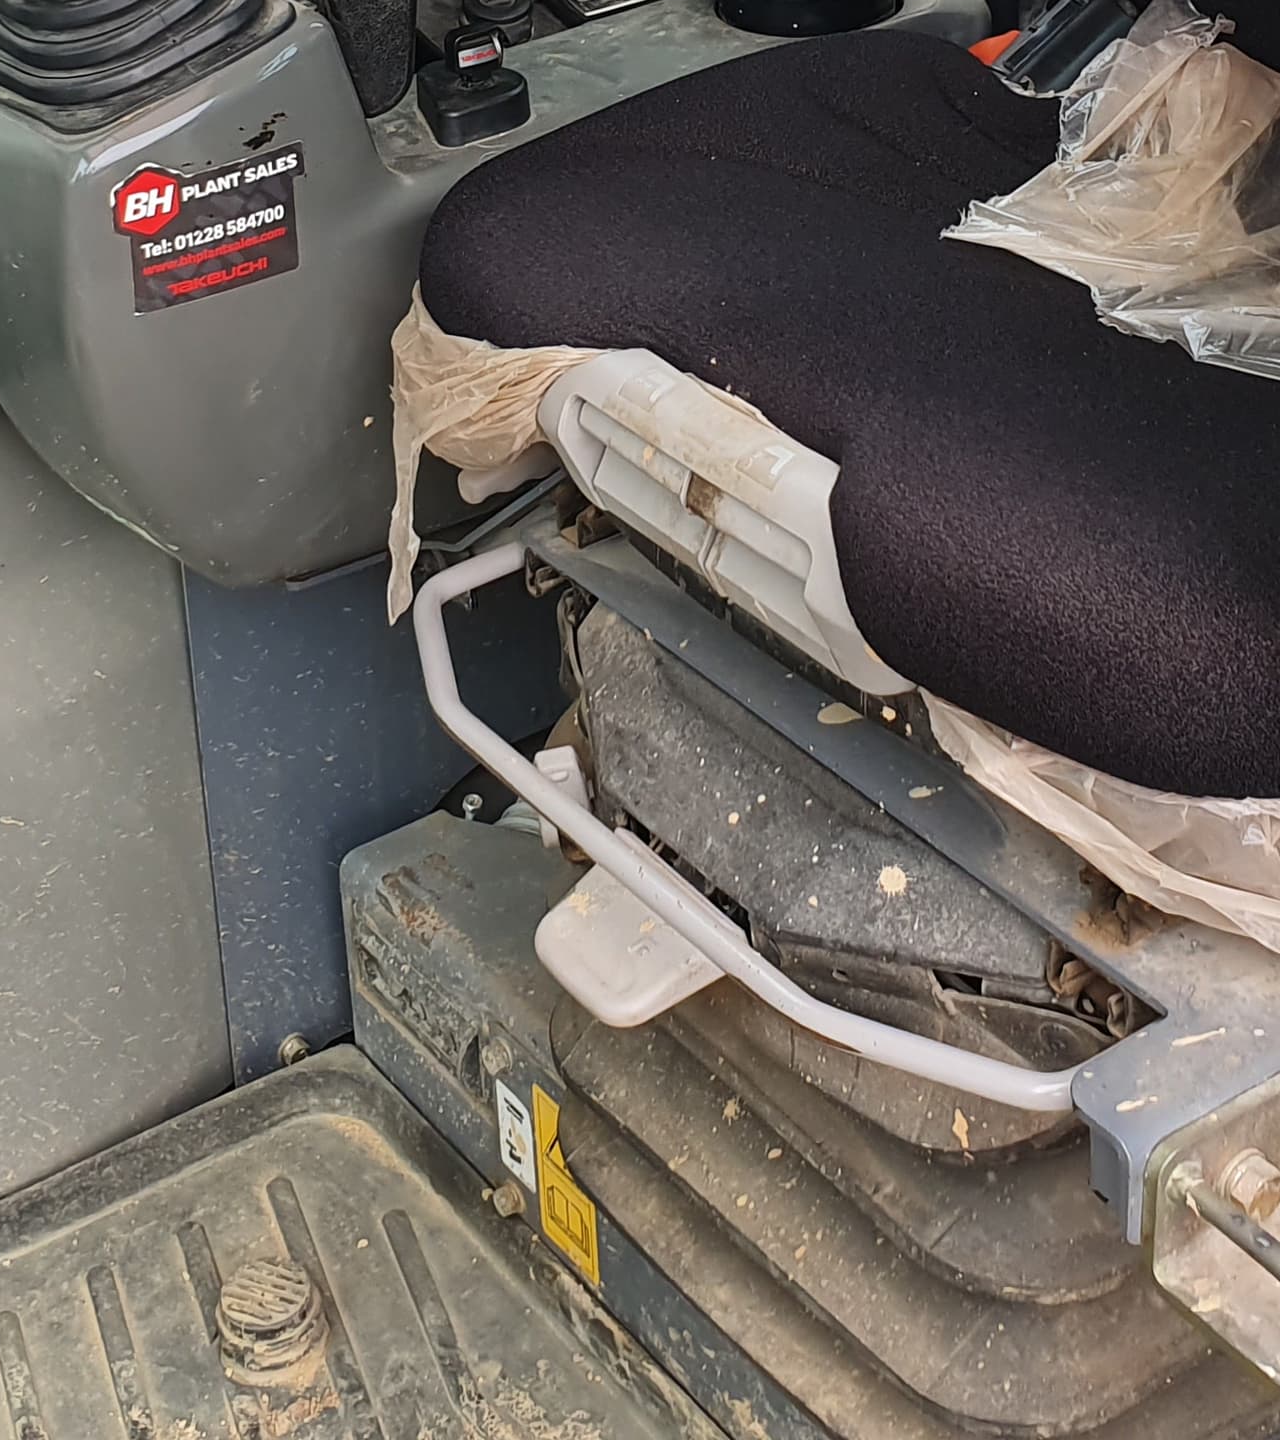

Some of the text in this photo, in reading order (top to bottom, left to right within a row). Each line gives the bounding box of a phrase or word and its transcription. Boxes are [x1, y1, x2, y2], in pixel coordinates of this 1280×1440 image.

[123, 153, 298, 224] BH PLANT SALES
[140, 204, 285, 259] Tel: 01228 584700
[142, 226, 287, 277] www.bhplantsales.com
